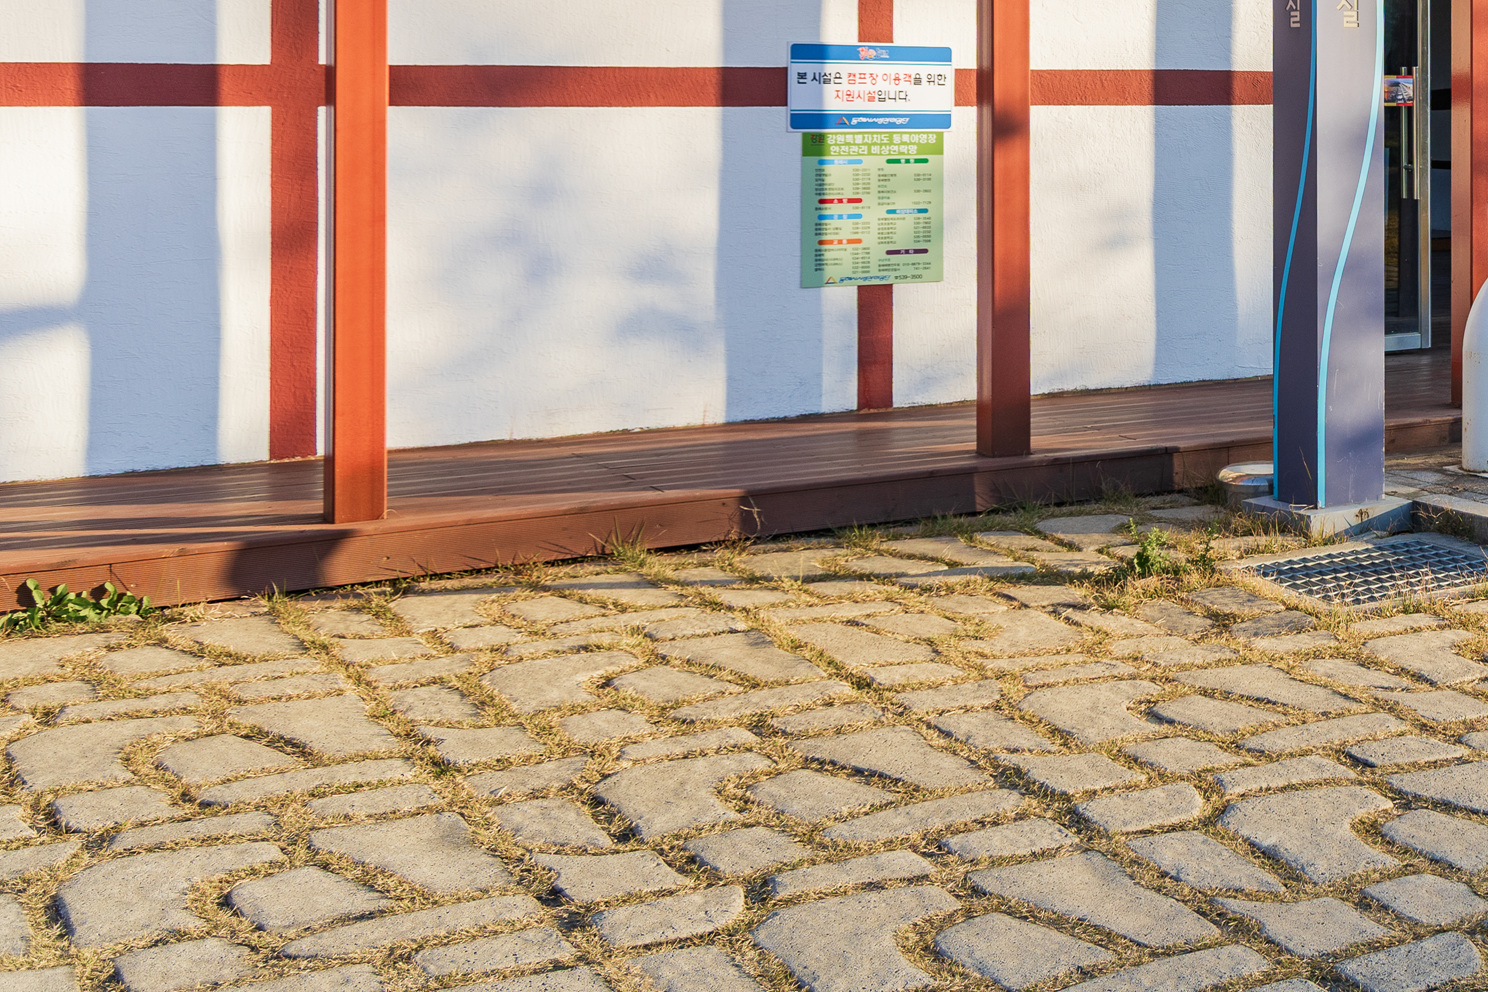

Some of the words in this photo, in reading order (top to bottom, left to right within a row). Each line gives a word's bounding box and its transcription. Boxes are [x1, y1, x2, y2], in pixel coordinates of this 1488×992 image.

[796, 71, 807, 84] 본
[811, 71, 843, 85] 시설은
[847, 72, 879, 85] 캠프장
[882, 72, 923, 86] 이용객을
[926, 73, 947, 86] 위한
[834, 89, 911, 103] 지원시설입니다.
[826, 134, 890, 144] 강원특별자치도
[893, 134, 937, 144] 등록야영장
[830, 145, 868, 155] 안전관리
[871, 145, 918, 155] 비상연락망
